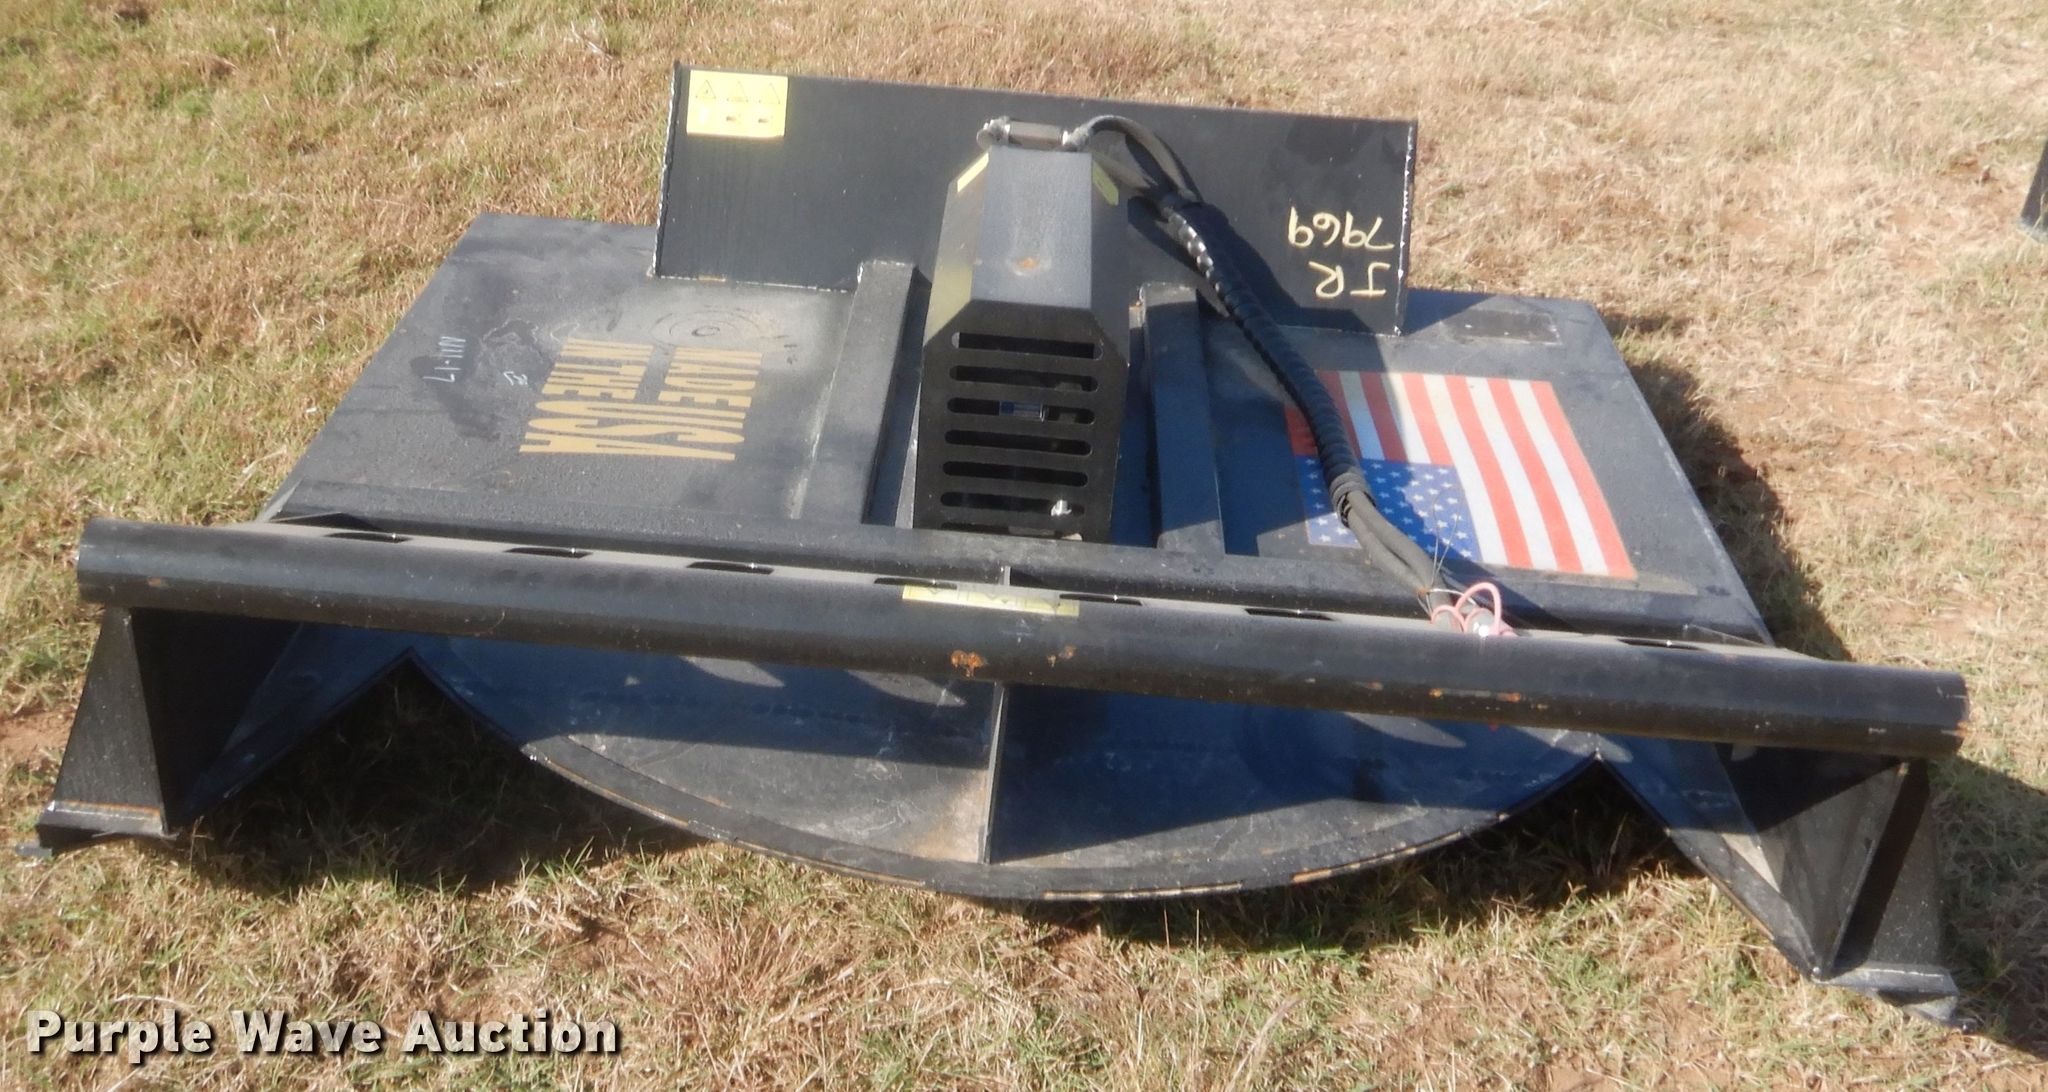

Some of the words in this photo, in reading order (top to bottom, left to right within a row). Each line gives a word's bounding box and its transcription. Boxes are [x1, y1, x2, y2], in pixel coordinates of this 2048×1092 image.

[1287, 206, 1395, 248] 7969
[559, 337, 655, 361] IN
[541, 363, 647, 400] THE
[658, 346, 763, 408] MADE
[519, 400, 746, 461] USA
